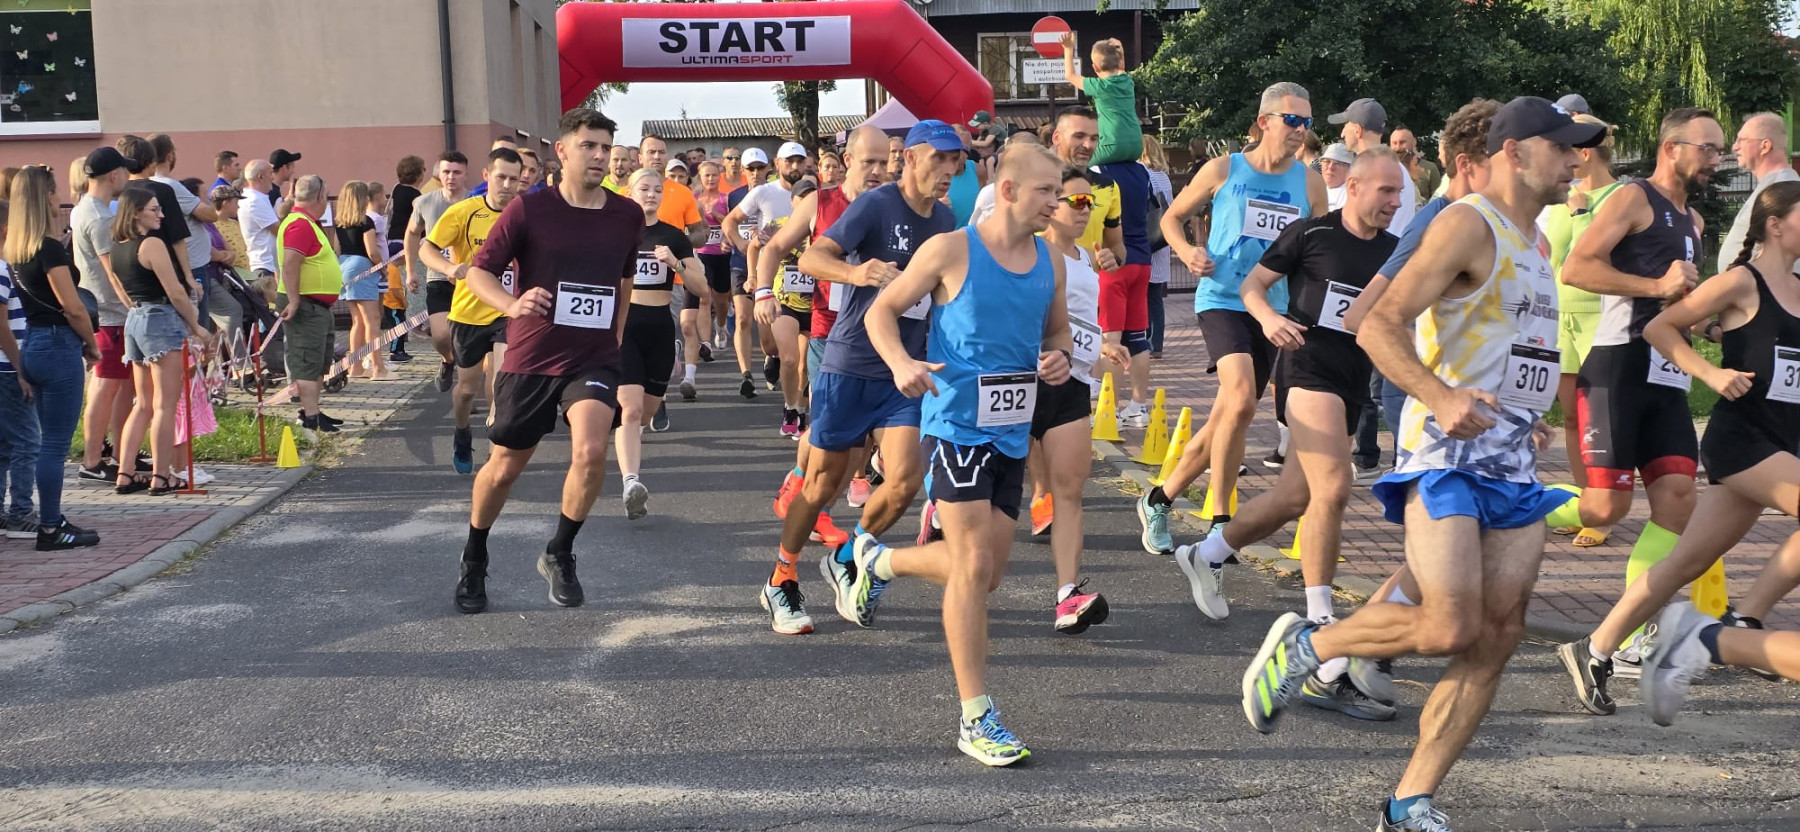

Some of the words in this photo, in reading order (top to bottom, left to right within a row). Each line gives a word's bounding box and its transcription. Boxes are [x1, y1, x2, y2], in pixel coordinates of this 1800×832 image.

[659, 21, 815, 53] START
[682, 55, 793, 64] ULTIMASPORT
[1256, 212, 1287, 231] 316
[710, 230, 720, 240] 75
[636, 261, 660, 276] 49
[790, 273, 814, 285] 243
[570, 296, 603, 317] 231
[1072, 330, 1093, 352] 42
[1516, 363, 1548, 392] 310
[990, 388, 1026, 412] 292
